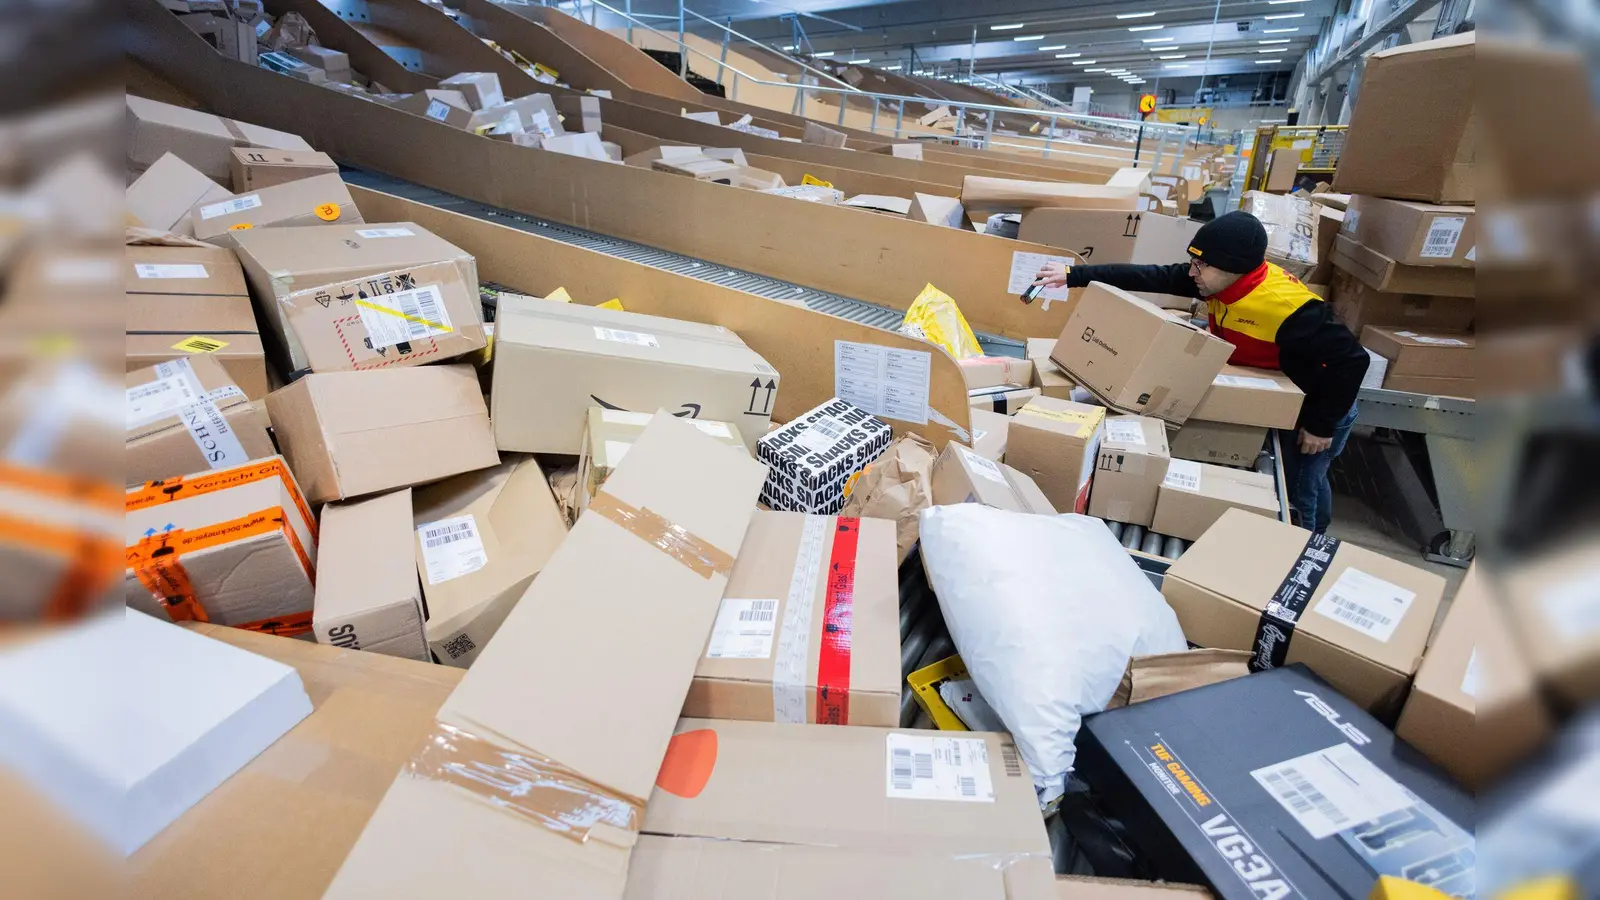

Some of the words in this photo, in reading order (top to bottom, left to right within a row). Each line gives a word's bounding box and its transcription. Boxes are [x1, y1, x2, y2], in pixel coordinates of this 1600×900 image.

[805, 429, 868, 468] SNACKS
[193, 471, 254, 490] Vorsicht
[181, 516, 267, 546] www.bockmeyer.de
[1293, 689, 1373, 746] ASUS
[1149, 762, 1182, 796] MONITOR
[1151, 742, 1175, 763] TUF
[1166, 761, 1213, 807] GAMING
